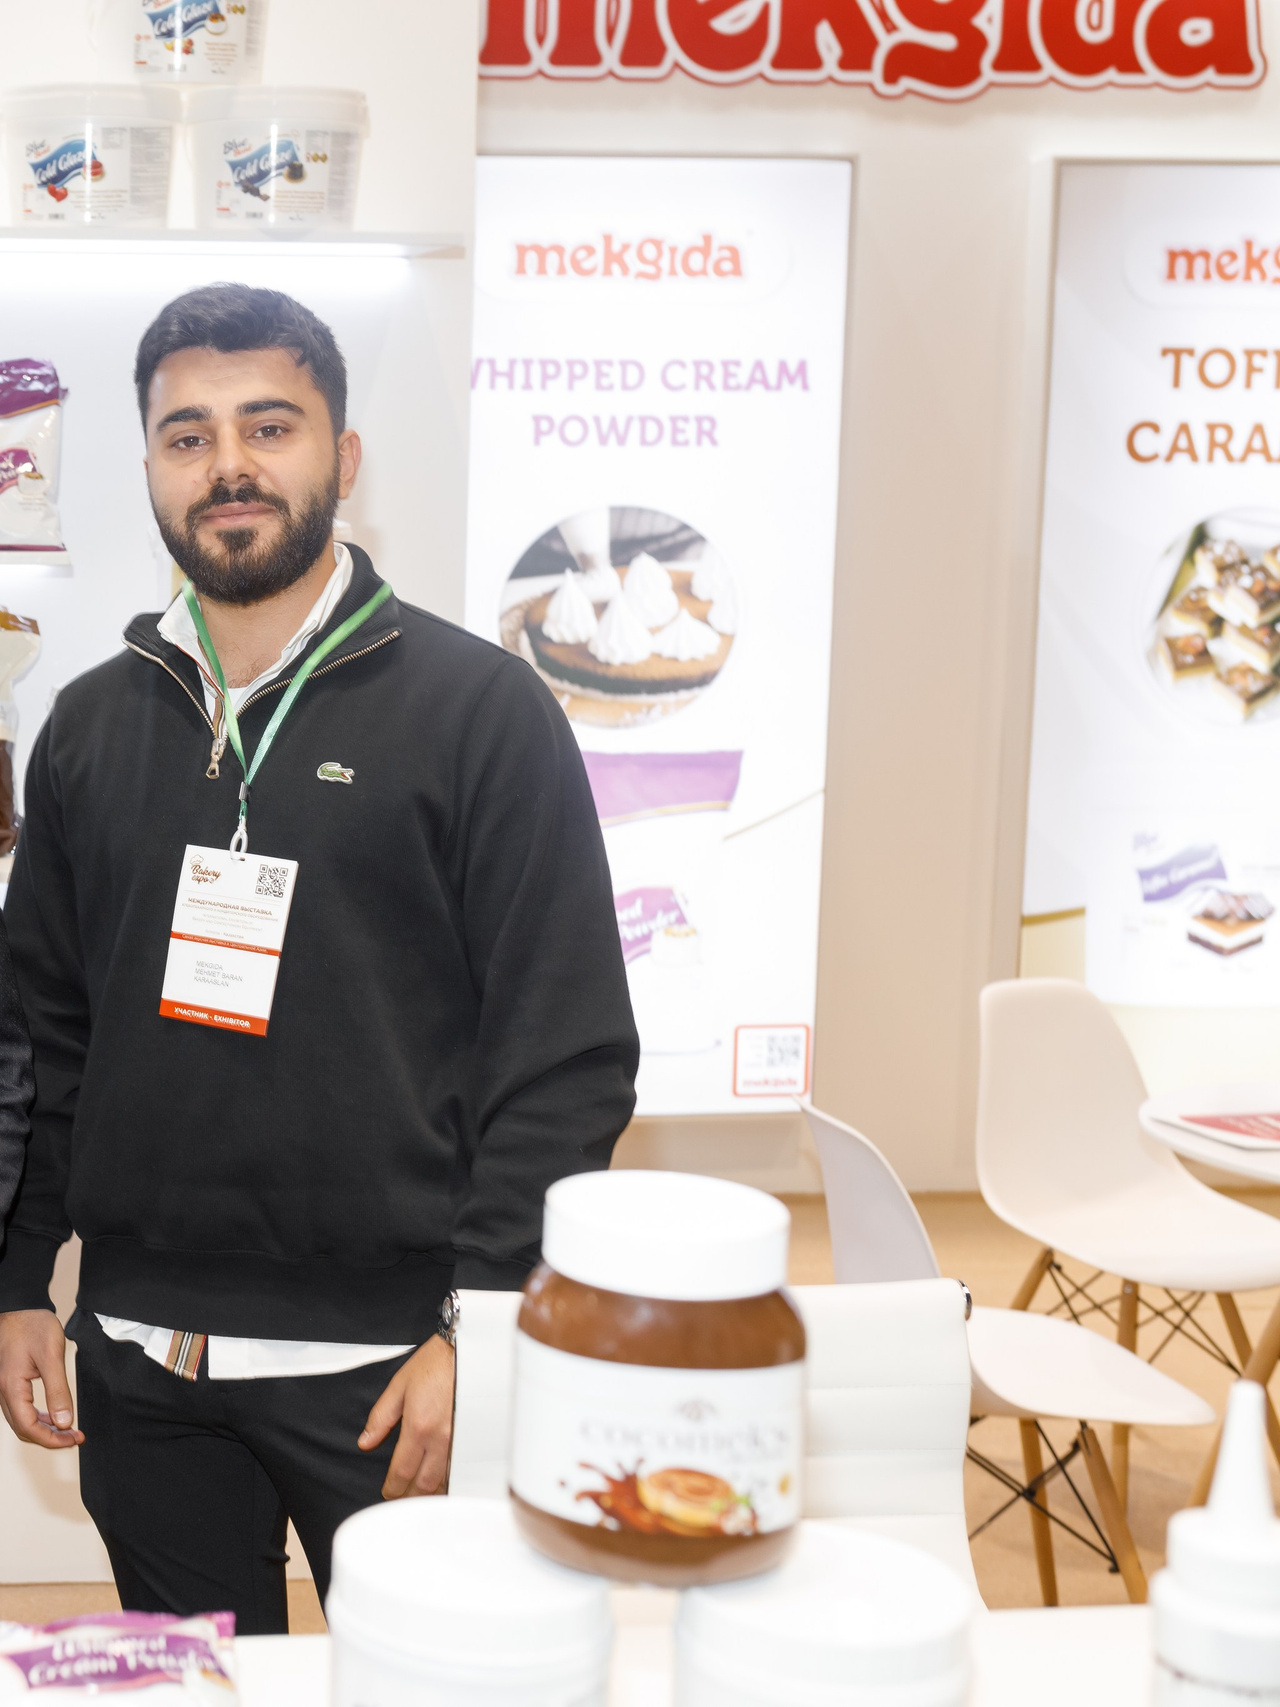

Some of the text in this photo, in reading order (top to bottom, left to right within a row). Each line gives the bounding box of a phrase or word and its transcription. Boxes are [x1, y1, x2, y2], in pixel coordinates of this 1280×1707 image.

[58, 151, 88, 171] Glaz
[1165, 239, 1280, 284] mek
[661, 358, 811, 392] CREAM
[531, 414, 720, 448] POWDER
[1126, 420, 1280, 463] CARA
[190, 864, 221, 880] Bakery
[191, 874, 208, 885] expo
[187, 897, 273, 916] МЕЖДУНАРОДНАЯ ВЫСТАВКА
[195, 960, 223, 971] MEKGIDA
[195, 968, 220, 977] MEHMET
[174, 1007, 209, 1020] УЧАСТНИК
[213, 1014, 250, 1028] EXHIBITOR
